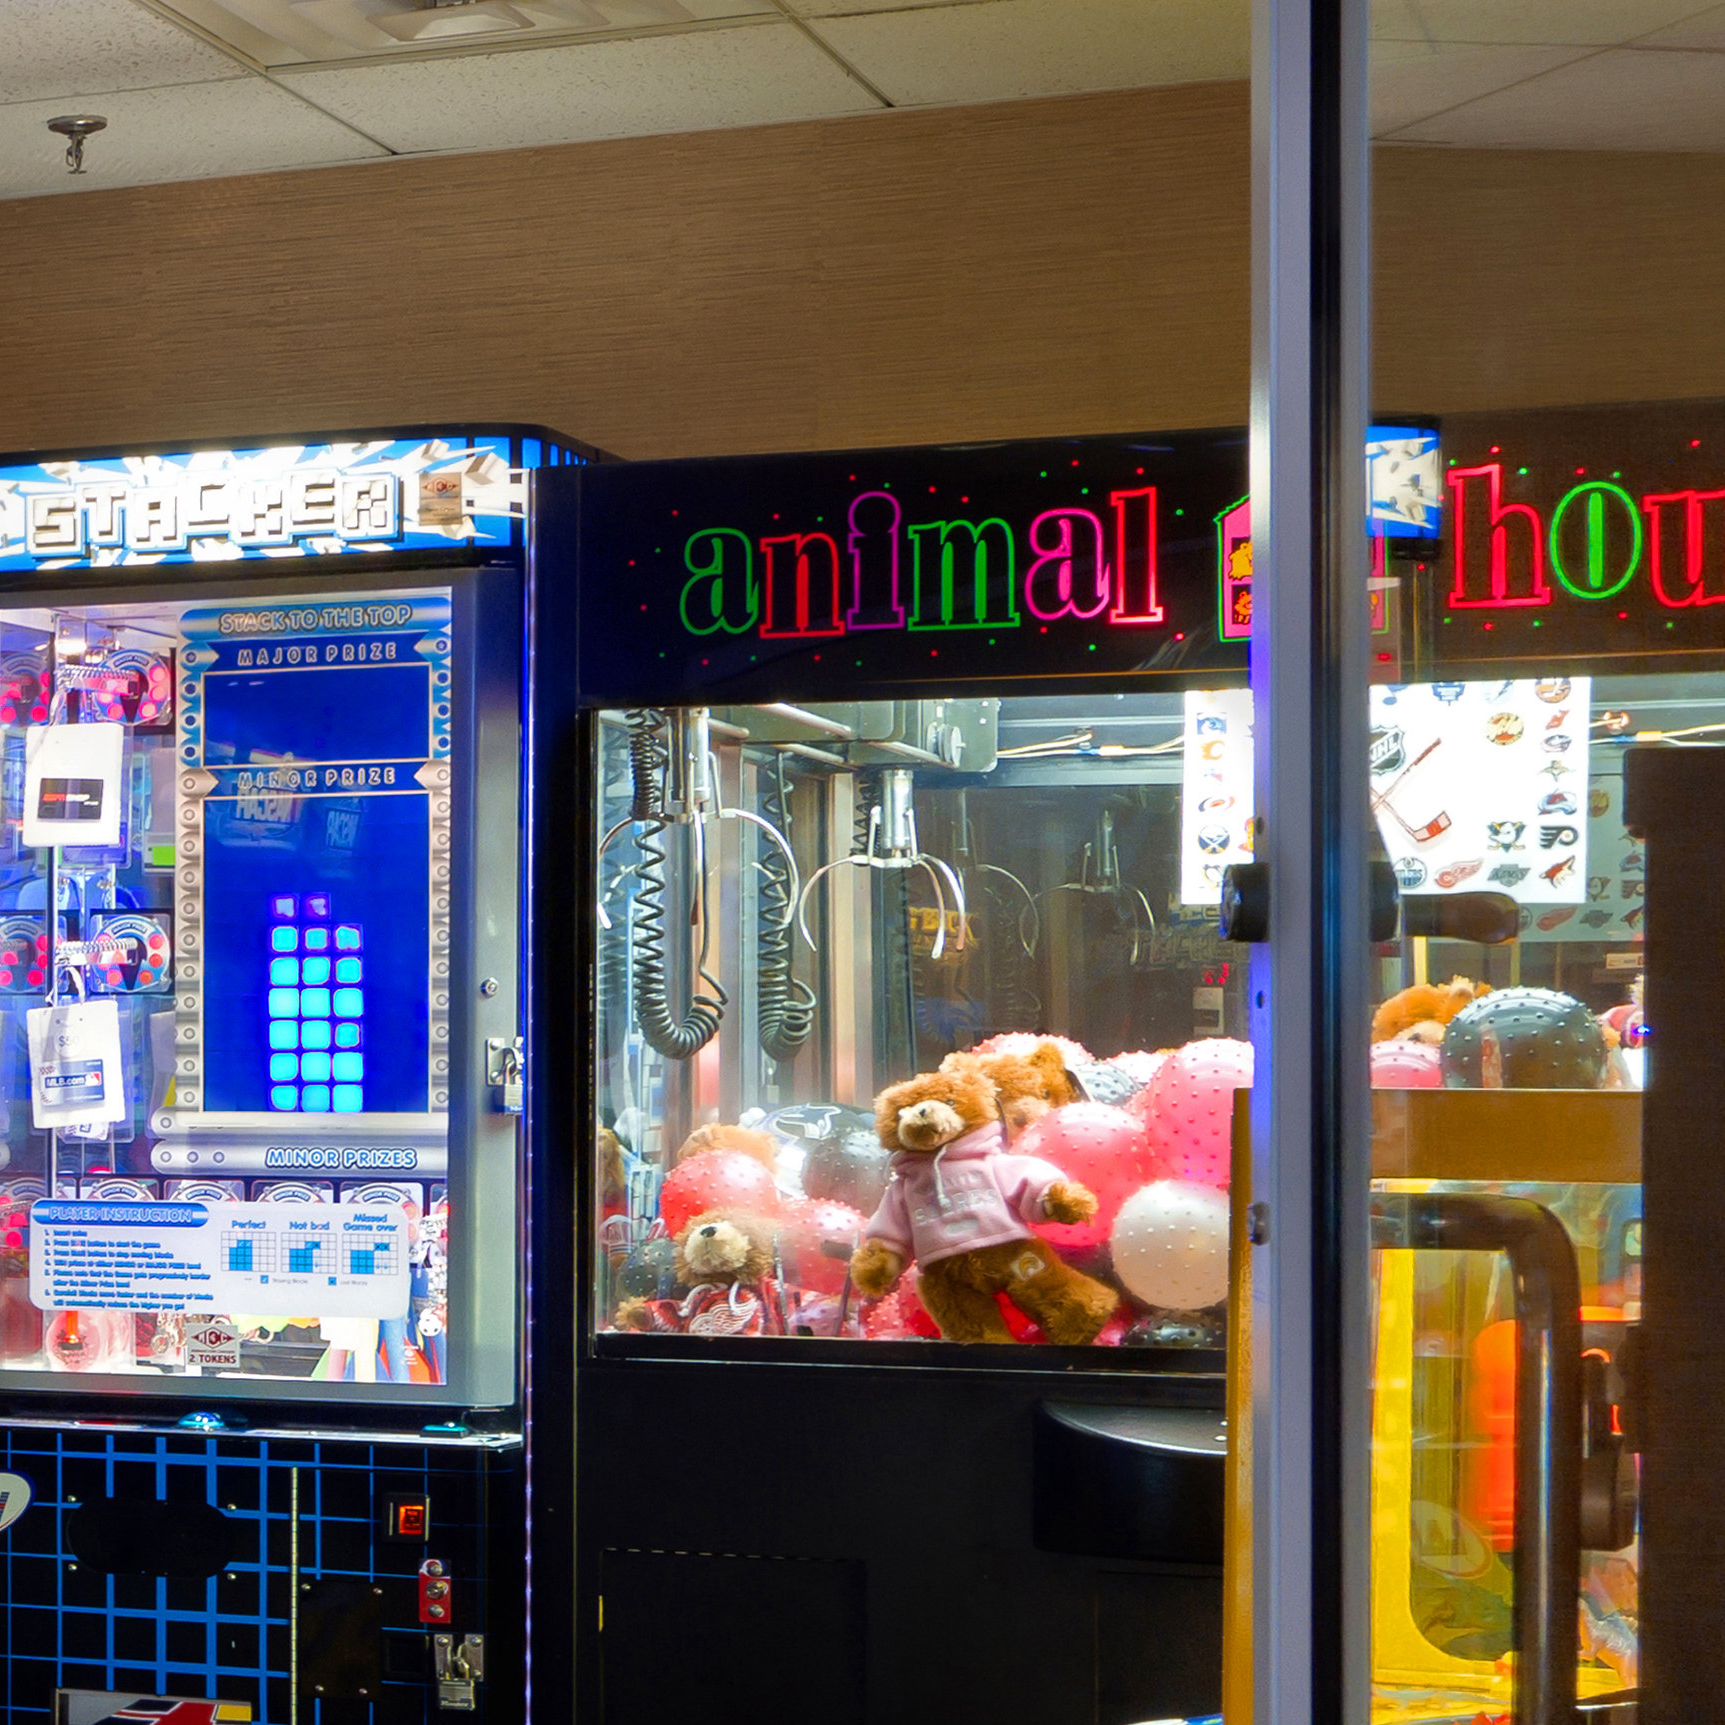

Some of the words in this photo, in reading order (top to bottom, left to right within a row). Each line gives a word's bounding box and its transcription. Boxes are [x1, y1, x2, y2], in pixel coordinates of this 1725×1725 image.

[26, 473, 402, 559] STACKER
[679, 487, 1163, 640] animal
[220, 612, 286, 634] STACK
[289, 610, 319, 630] TO
[322, 607, 364, 628] THE
[367, 605, 412, 626] TOP
[238, 646, 318, 666] MAJOR
[326, 642, 397, 662] PRIZE
[237, 770, 317, 790] MINOR
[325, 767, 396, 786] PRIZE
[46, 1074, 87, 1088] MLB.com
[266, 1147, 339, 1169] MINOR
[343, 1148, 419, 1170] PRIZES
[50, 1206, 99, 1221] PLAYER
[101, 1208, 193, 1224] INSTRUCTION
[353, 1213, 388, 1223] Missed
[231, 1220, 267, 1229] Perfect
[289, 1221, 304, 1230] Not
[305, 1221, 330, 1230] bad
[342, 1222, 373, 1232] Game
[376, 1223, 398, 1232] over
[189, 1354, 196, 1363] 2
[199, 1354, 237, 1364] TOKENS
